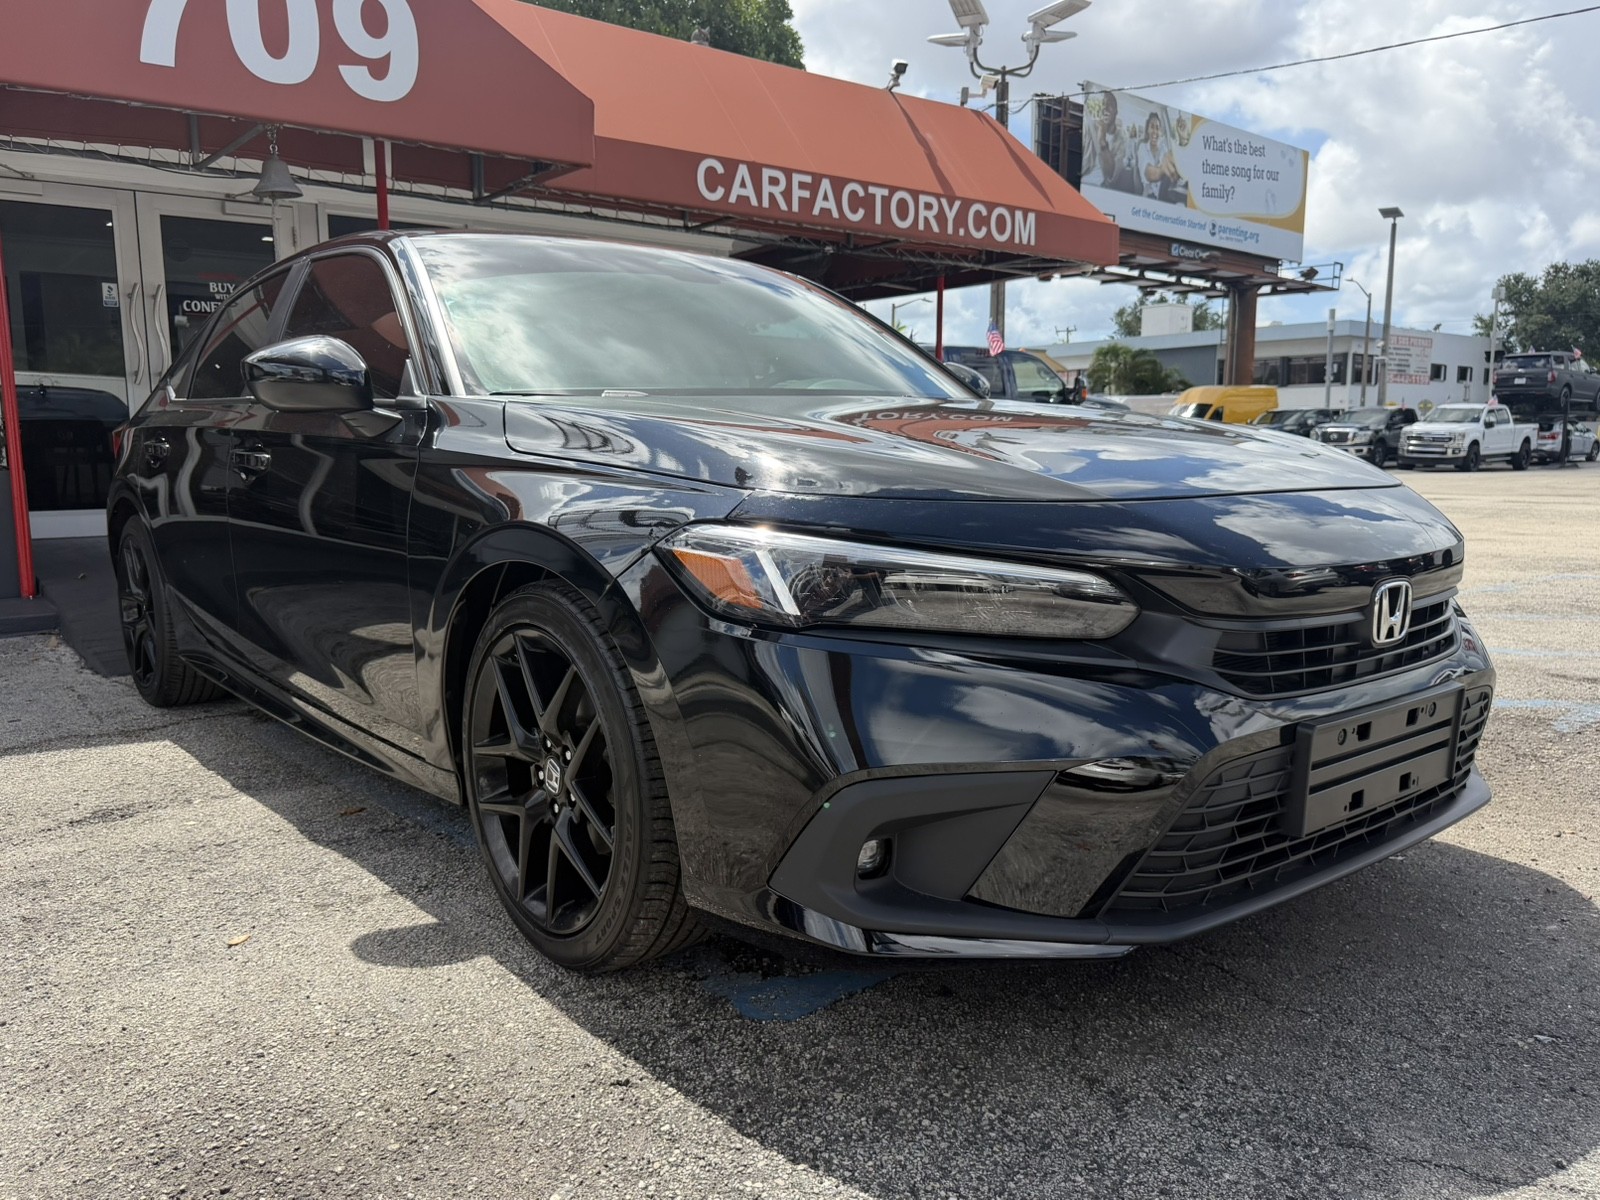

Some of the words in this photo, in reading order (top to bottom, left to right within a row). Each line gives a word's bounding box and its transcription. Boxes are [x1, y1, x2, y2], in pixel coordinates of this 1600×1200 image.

[140, 0, 420, 102] 709
[1202, 135, 1232, 153] What's
[1234, 138, 1247, 155] the
[1249, 141, 1266, 158] best
[1202, 159, 1229, 177] theme
[1231, 166, 1251, 182] song
[1253, 164, 1265, 180] for
[1266, 170, 1279, 181] our
[696, 158, 1037, 246] CARFACTORY.COM
[1202, 182, 1235, 203] family?
[1131, 207, 1141, 217] Get
[1142, 209, 1151, 219] the
[1152, 211, 1186, 226] Conversation
[1187, 218, 1207, 231] Started
[1218, 225, 1260, 244] parenting.org
[209, 282, 235, 293] BUY
[183, 300, 222, 313] CONF
